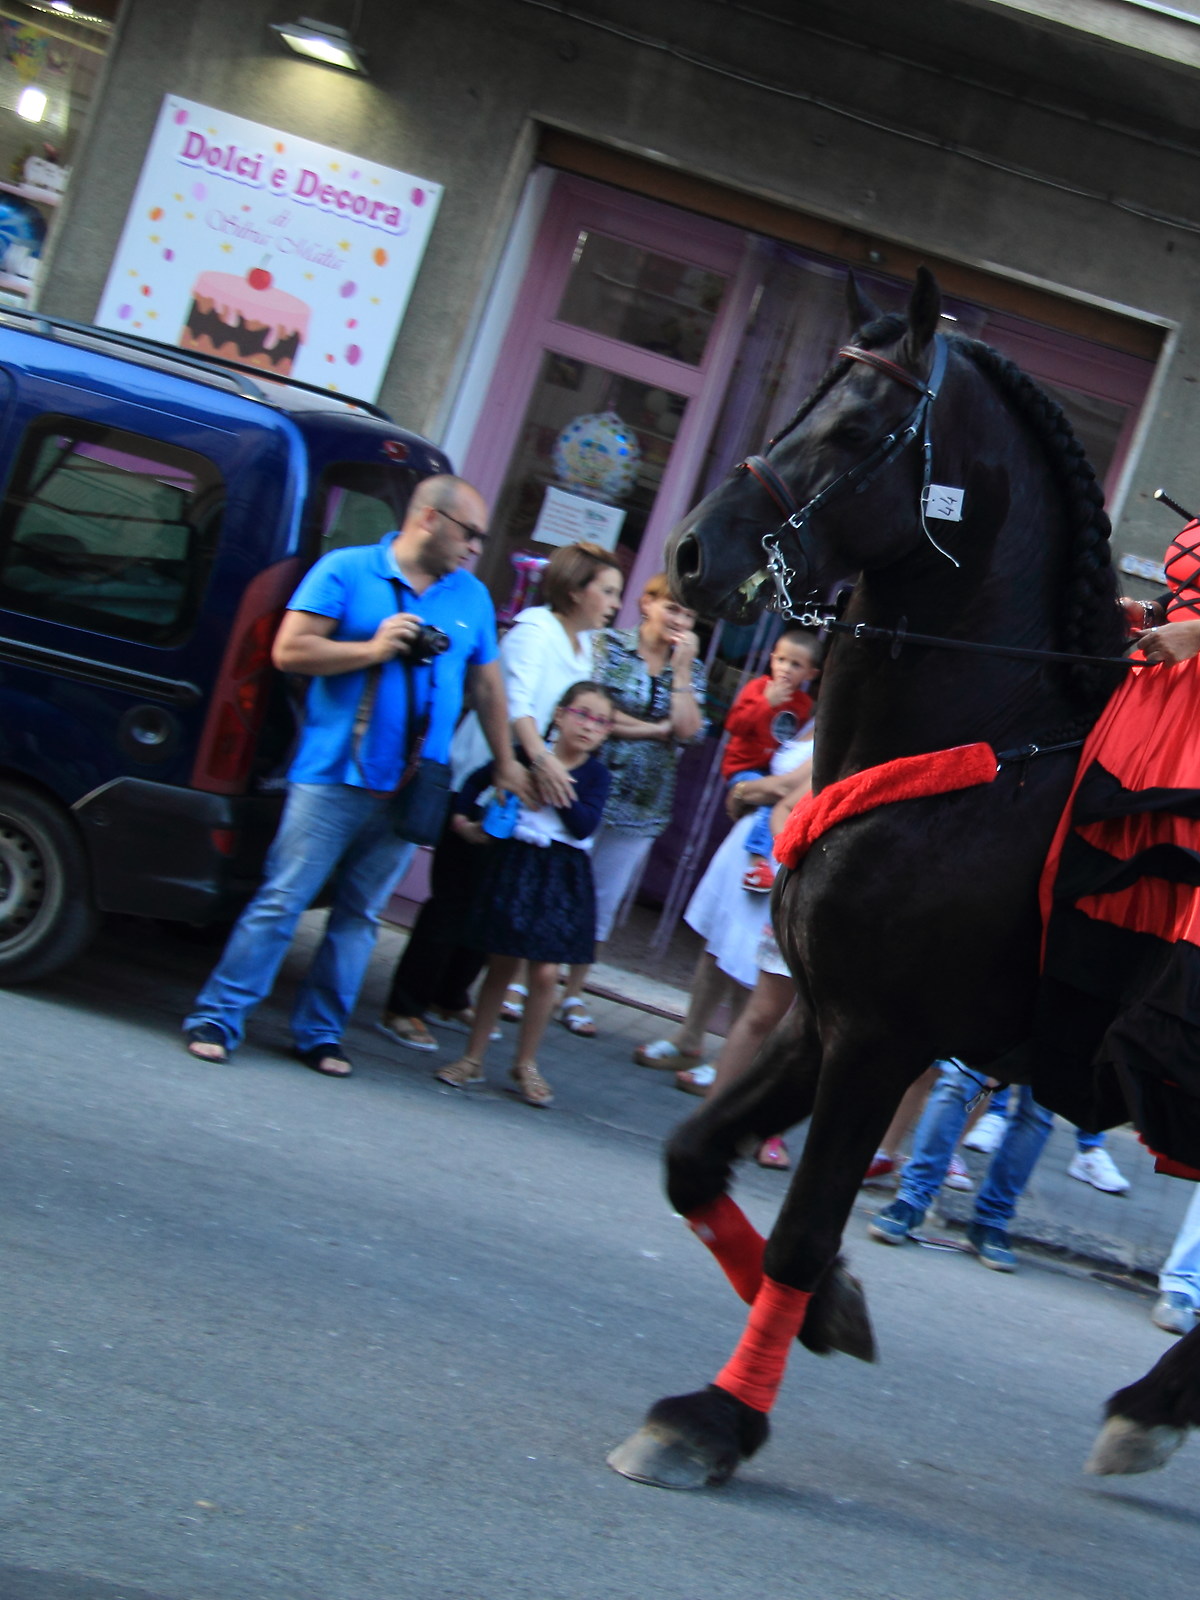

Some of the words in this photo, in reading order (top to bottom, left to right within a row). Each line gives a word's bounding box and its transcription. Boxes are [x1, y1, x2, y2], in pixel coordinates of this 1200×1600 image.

[181, 131, 263, 181] Dolci
[270, 168, 287, 188] e
[294, 169, 401, 227] Decora
[937, 496, 958, 517] 44
